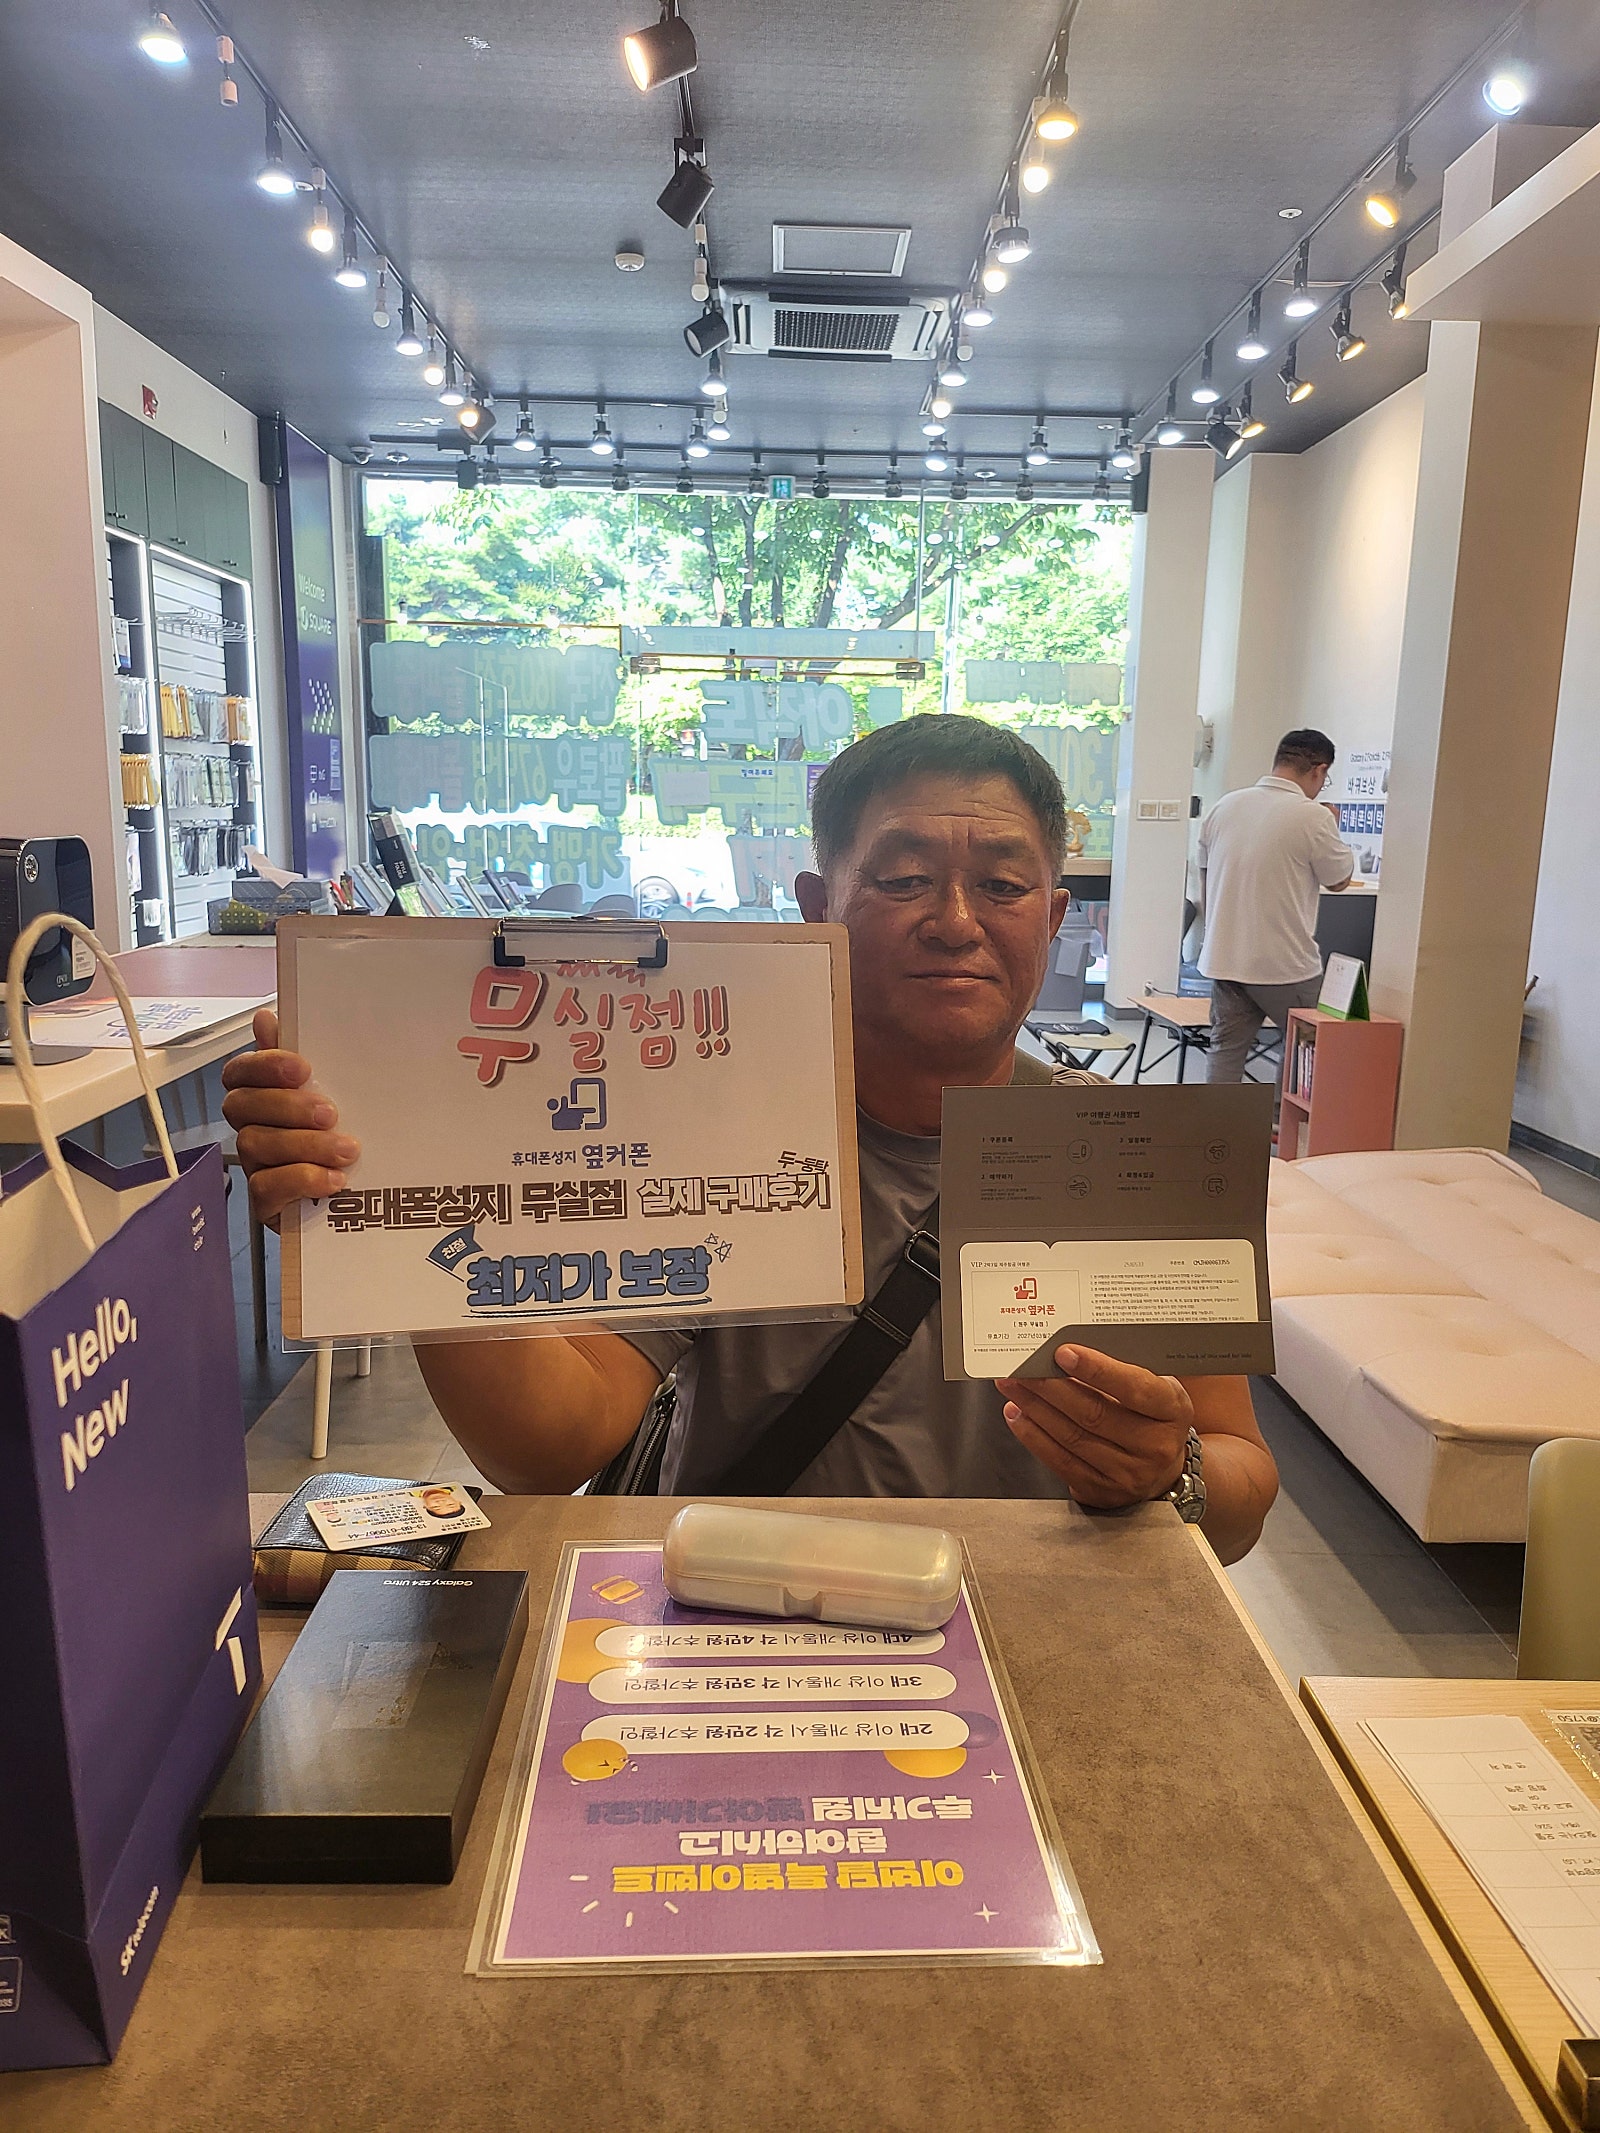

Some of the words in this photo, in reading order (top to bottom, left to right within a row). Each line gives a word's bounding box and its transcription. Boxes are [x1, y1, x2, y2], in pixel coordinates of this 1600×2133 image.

[297, 573, 327, 604] Welcome
[308, 613, 333, 636] SQUARE
[457, 965, 732, 1087] 무실점!!
[511, 1151, 577, 1167] 휴대폰성지
[581, 1142, 652, 1169] 옆커폰
[326, 1184, 512, 1233] 휴대폰성지
[520, 1180, 628, 1223] 무실점
[441, 1237, 468, 1260] 친절
[466, 1249, 612, 1307] 최저가
[618, 1245, 713, 1300] 보장
[1028, 1304, 1056, 1315] 옆커폰
[51, 1296, 139, 1409] Hello,
[60, 1378, 129, 1492] New
[382, 1579, 411, 1587] Ultra
[411, 1579, 432, 1587] S24
[432, 1578, 473, 1587] Galaxy
[706, 1634, 755, 1646] 4만원
[760, 1634, 778, 1646] 각
[784, 1633, 836, 1645] 개통시
[842, 1633, 877, 1645] 이상
[882, 1632, 913, 1644] 4대
[624, 1678, 699, 1692] 추가할인
[705, 1677, 756, 1691] 3만원
[761, 1676, 781, 1690] 각
[786, 1676, 842, 1689] 개통시
[847, 1675, 884, 1689] 이상
[890, 1674, 922, 1688] 3대
[619, 1725, 699, 1741] 추가할인
[705, 1725, 758, 1739] 2만원
[764, 1724, 784, 1739] 각
[790, 1723, 849, 1738] 개통시
[855, 1723, 893, 1737] 이상
[899, 1722, 932, 1735] 2대
[811, 1795, 973, 1820] 추가지원
[1531, 1803, 1551, 1811] 오신
[1554, 1802, 1573, 1810] 보고
[679, 1827, 887, 1856] 참여하시고
[611, 1861, 828, 1893] 특별이벤트
[835, 1859, 964, 1889] 이번달
